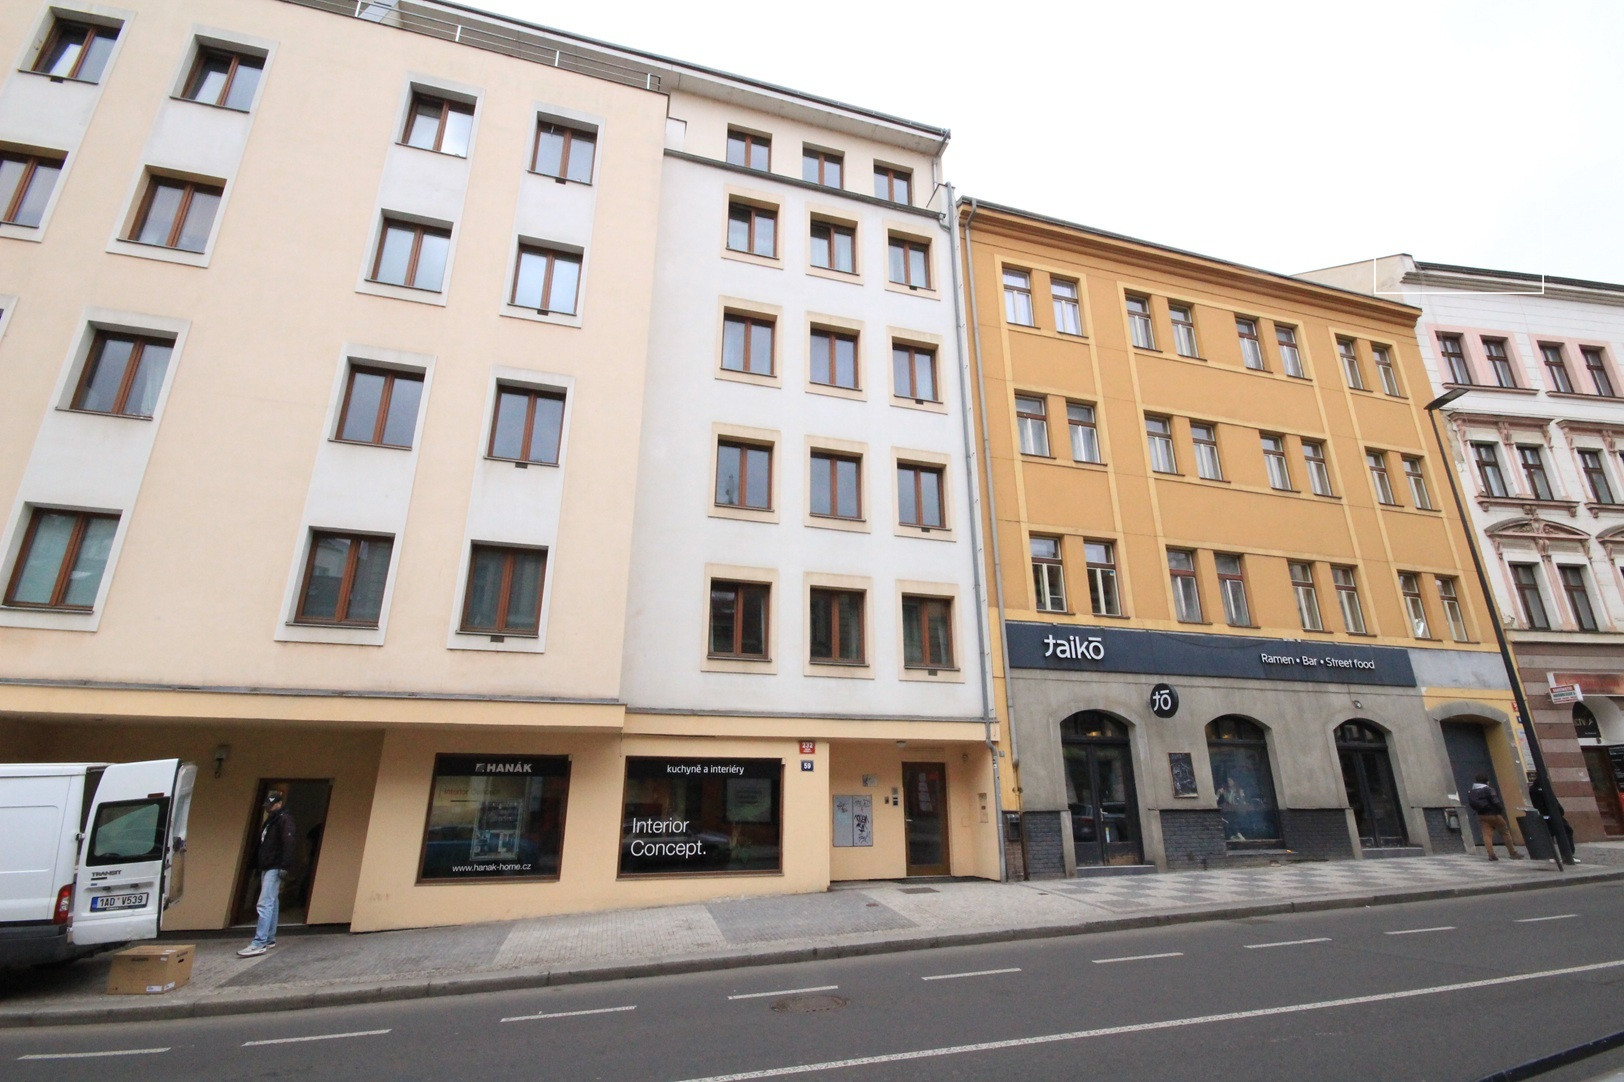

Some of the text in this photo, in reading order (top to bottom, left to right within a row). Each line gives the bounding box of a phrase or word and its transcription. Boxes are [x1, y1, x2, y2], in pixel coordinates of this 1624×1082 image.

[1260, 653, 1376, 669] Ramen Bar Street food
[486, 761, 533, 773] HANÁK
[666, 764, 702, 776] kuchyně
[710, 765, 745, 776] interiéry
[803, 762, 812, 770] 59
[632, 817, 690, 834] Interior
[630, 839, 707, 859] Concept.
[452, 863, 532, 872] www.hanak-home.cz
